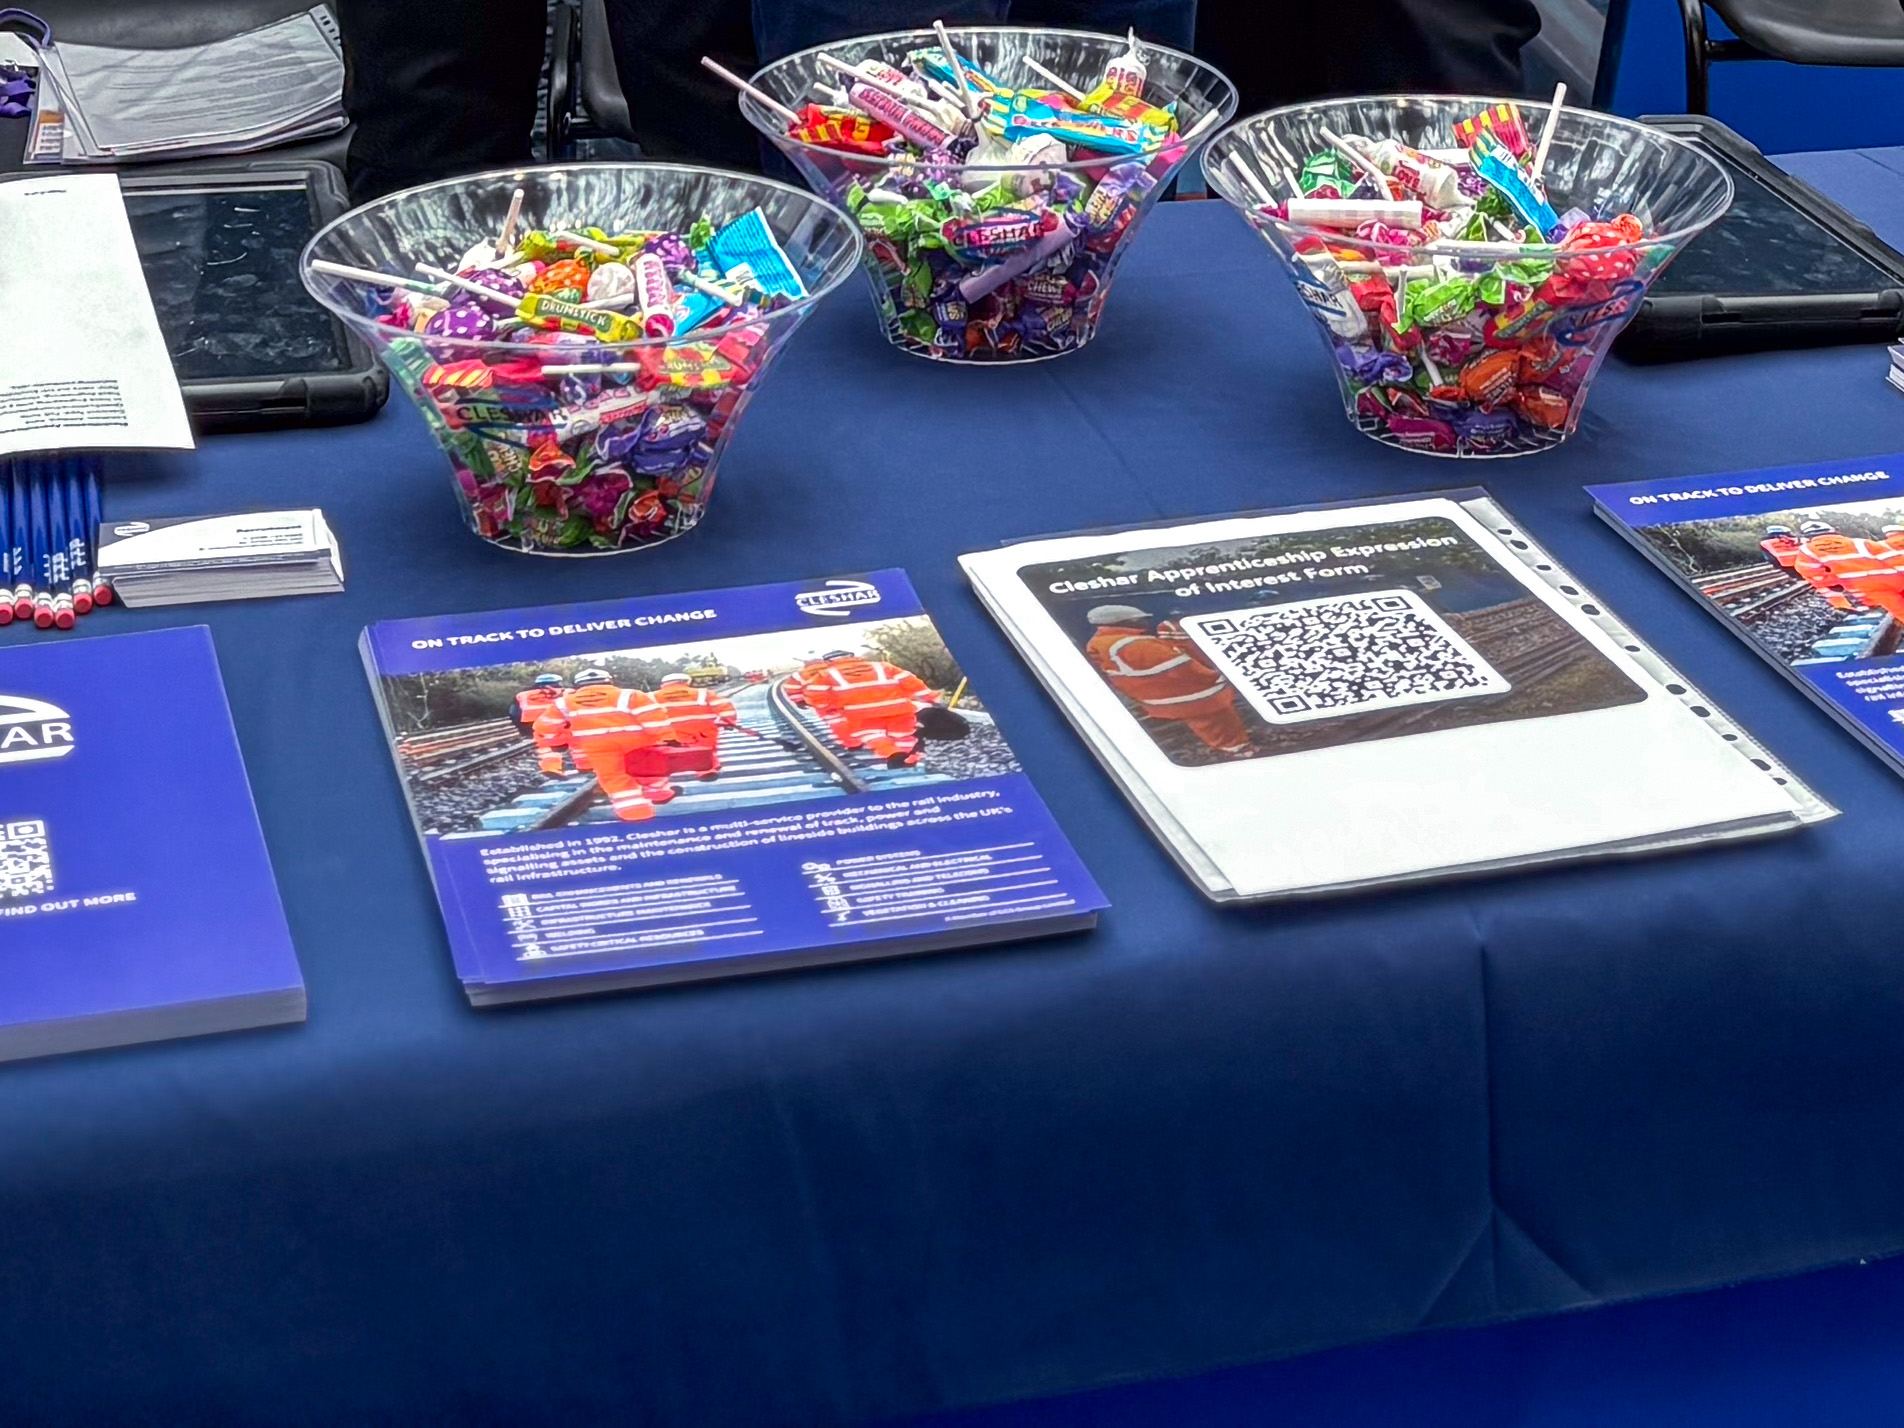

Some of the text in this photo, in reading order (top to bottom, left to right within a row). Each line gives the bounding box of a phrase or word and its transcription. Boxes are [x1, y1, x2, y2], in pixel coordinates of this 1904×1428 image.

[541, 302, 606, 326] DRUMSTICK
[1629, 470, 1889, 505] ON TRACK TO DELIVER CHANGE
[1049, 534, 1458, 595] Cleshar Apprenticeship Expression
[1175, 561, 1369, 599] of Interest Form
[411, 609, 717, 650] ON TRACK TO DELIVER CHANGE
[41, 899, 79, 913] OUT
[83, 892, 136, 906] MORE
